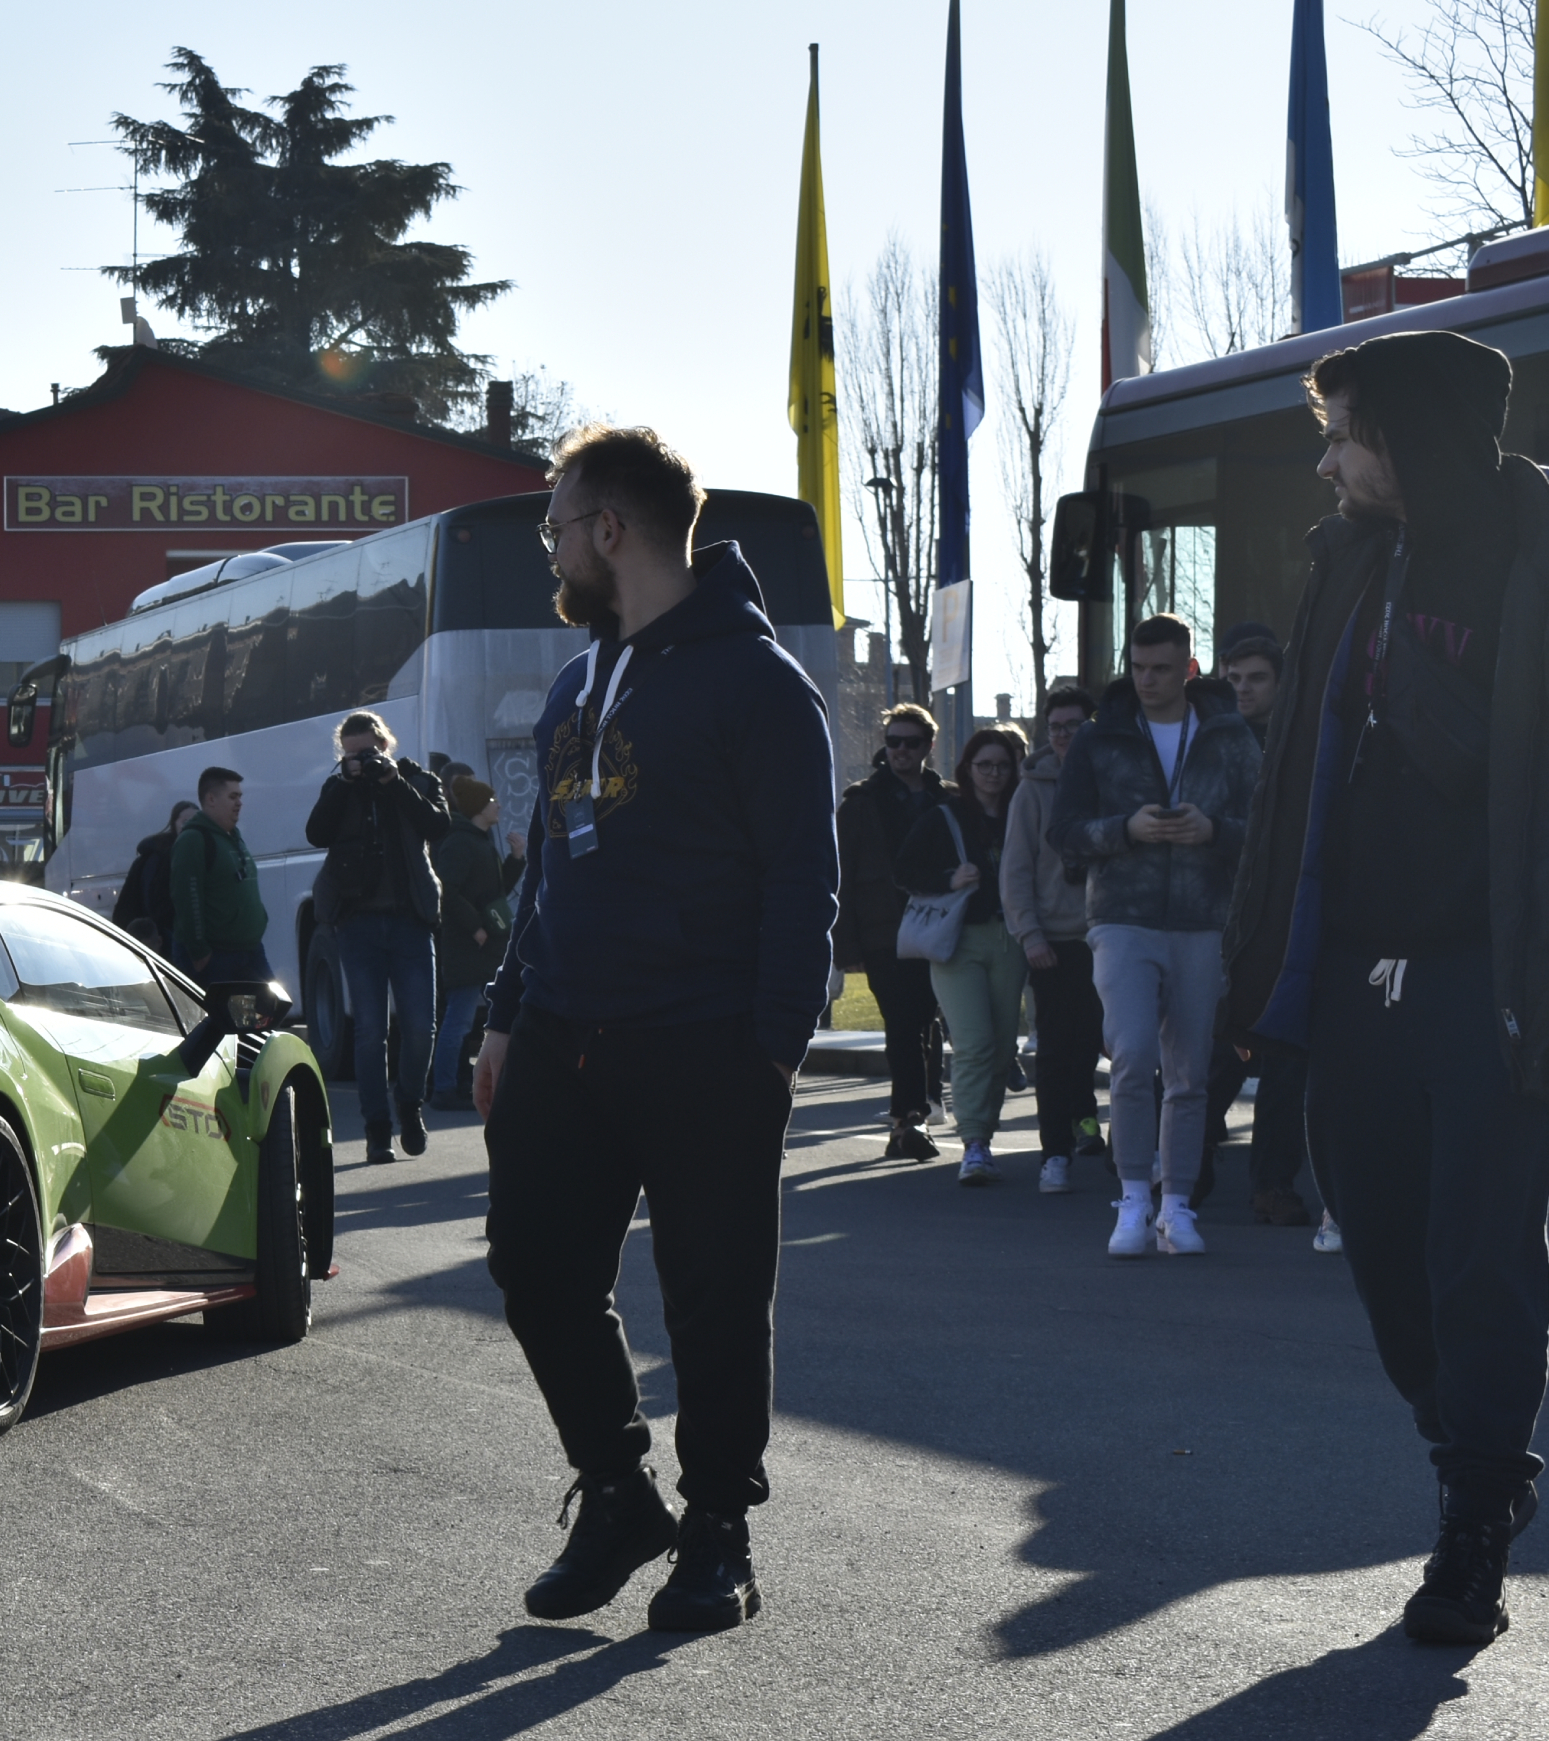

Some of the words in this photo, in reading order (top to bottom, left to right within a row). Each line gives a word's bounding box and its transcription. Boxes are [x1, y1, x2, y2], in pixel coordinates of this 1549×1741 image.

[16, 485, 109, 523] Bar
[131, 484, 397, 523] Ristorante
[168, 1103, 224, 1140] STO
